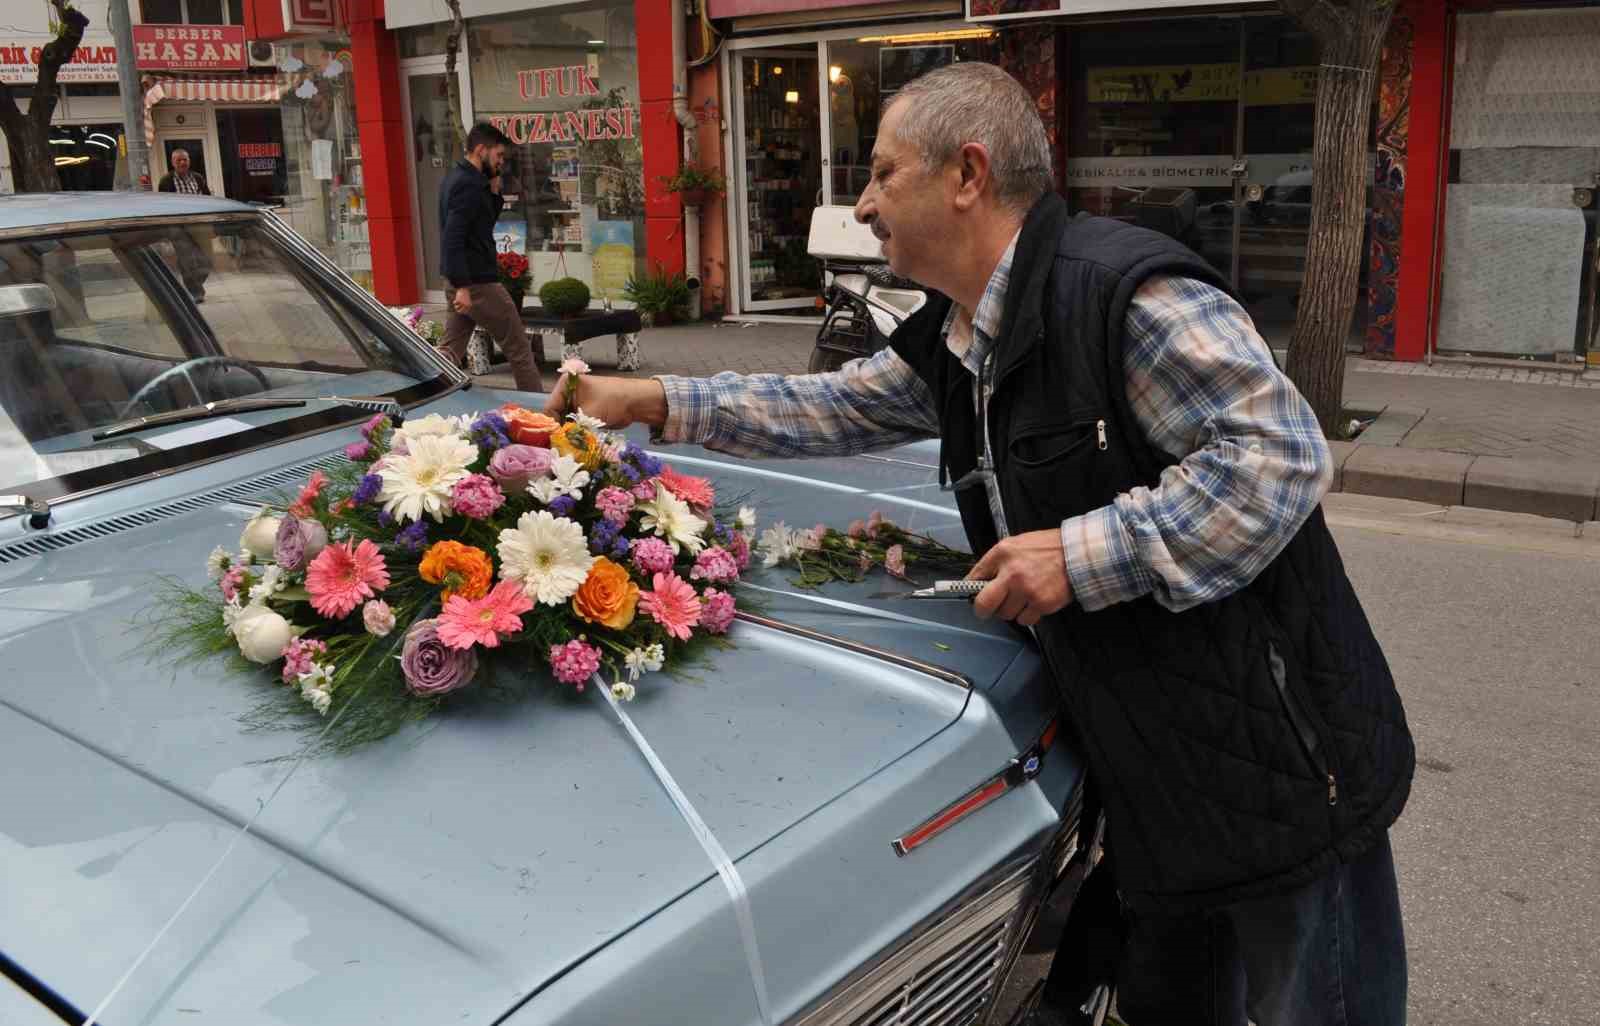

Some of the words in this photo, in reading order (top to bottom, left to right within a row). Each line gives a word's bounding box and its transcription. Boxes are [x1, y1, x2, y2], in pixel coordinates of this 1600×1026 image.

[155, 28, 223, 40] BERBER
[0, 43, 29, 65] RİK
[136, 42, 242, 61] HASAN
[517, 64, 600, 101] UFUK
[489, 99, 634, 145] ECZANESİ
[1151, 163, 1230, 177] BİOMETRİK
